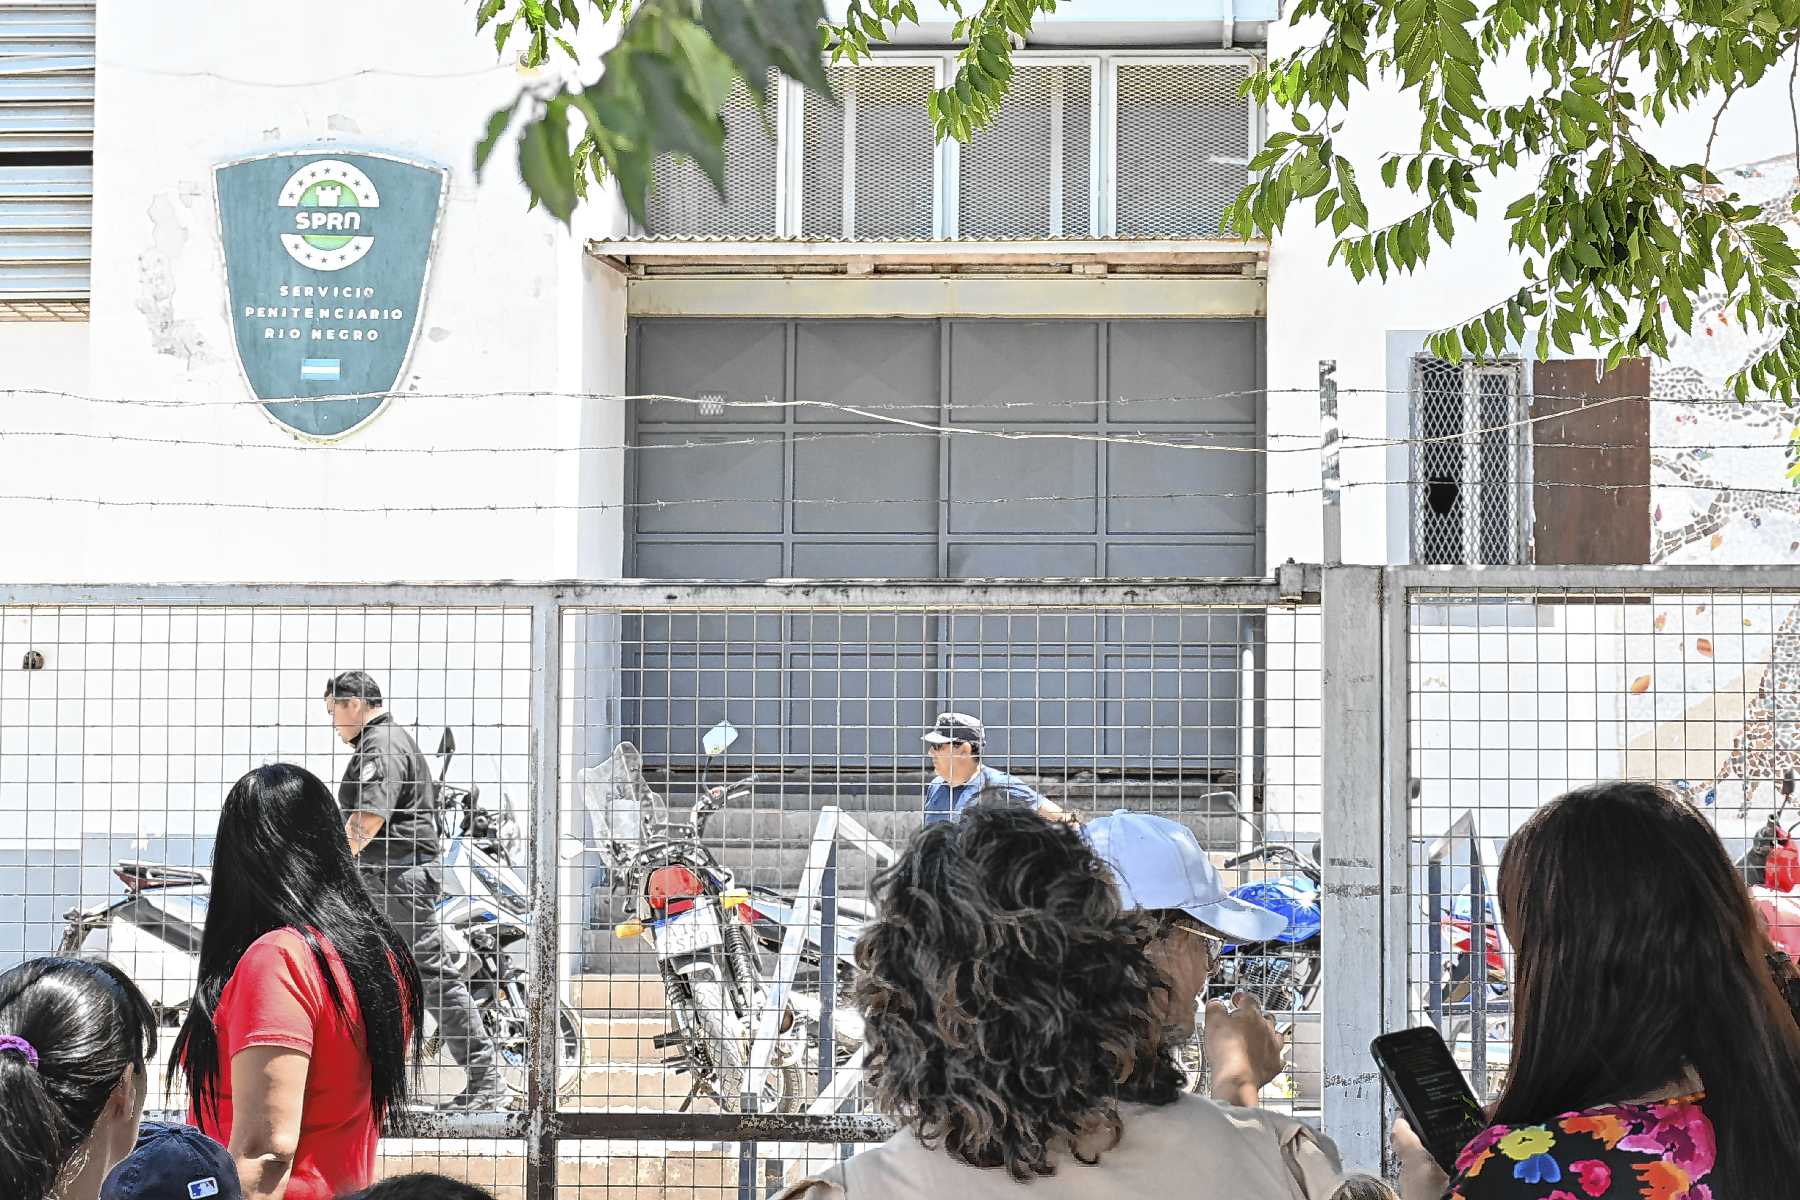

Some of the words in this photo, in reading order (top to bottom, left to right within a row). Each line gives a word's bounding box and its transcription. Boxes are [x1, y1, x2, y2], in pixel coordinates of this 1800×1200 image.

[279, 285, 375, 298] SERVICIO
[245, 306, 403, 320] PENITENCIARIO
[264, 327, 301, 339] RIO
[311, 328, 379, 341] NEGRO
